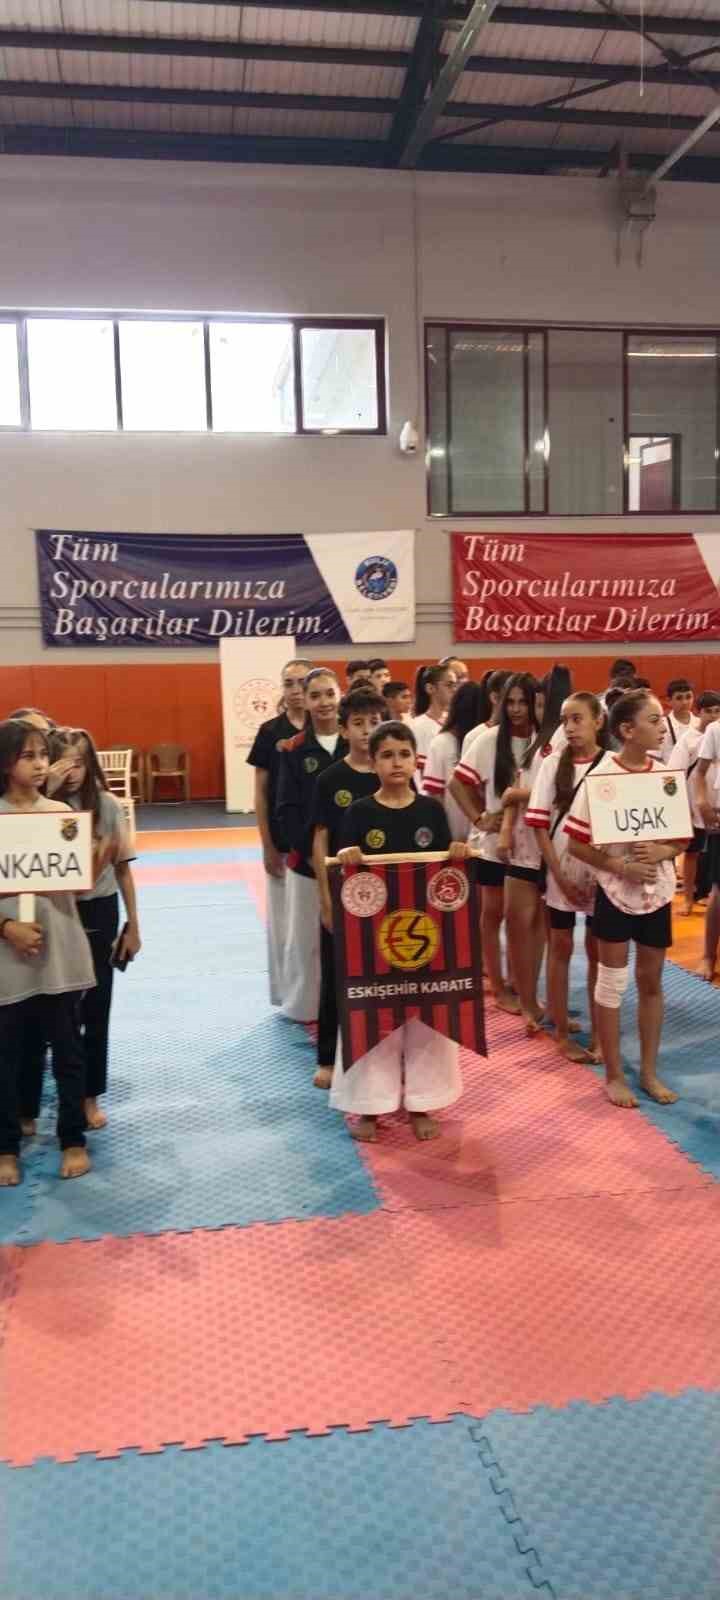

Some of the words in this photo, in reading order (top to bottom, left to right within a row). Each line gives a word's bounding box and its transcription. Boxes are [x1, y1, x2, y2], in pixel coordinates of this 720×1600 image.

[49, 534, 119, 562] Tüm
[463, 535, 526, 563] Tüm
[50, 571, 286, 605] Sporcularımıza
[462, 570, 677, 604] Sporcularımıza
[53, 609, 199, 641] Başarılar
[209, 608, 331, 638] Dilerim.
[464, 605, 597, 636] Başarılar
[604, 605, 717, 632] Dilerim.
[613, 806, 668, 837] UŞAK
[347, 979, 418, 1000] ESKİŞEHİR
[420, 977, 473, 994] KARATE
